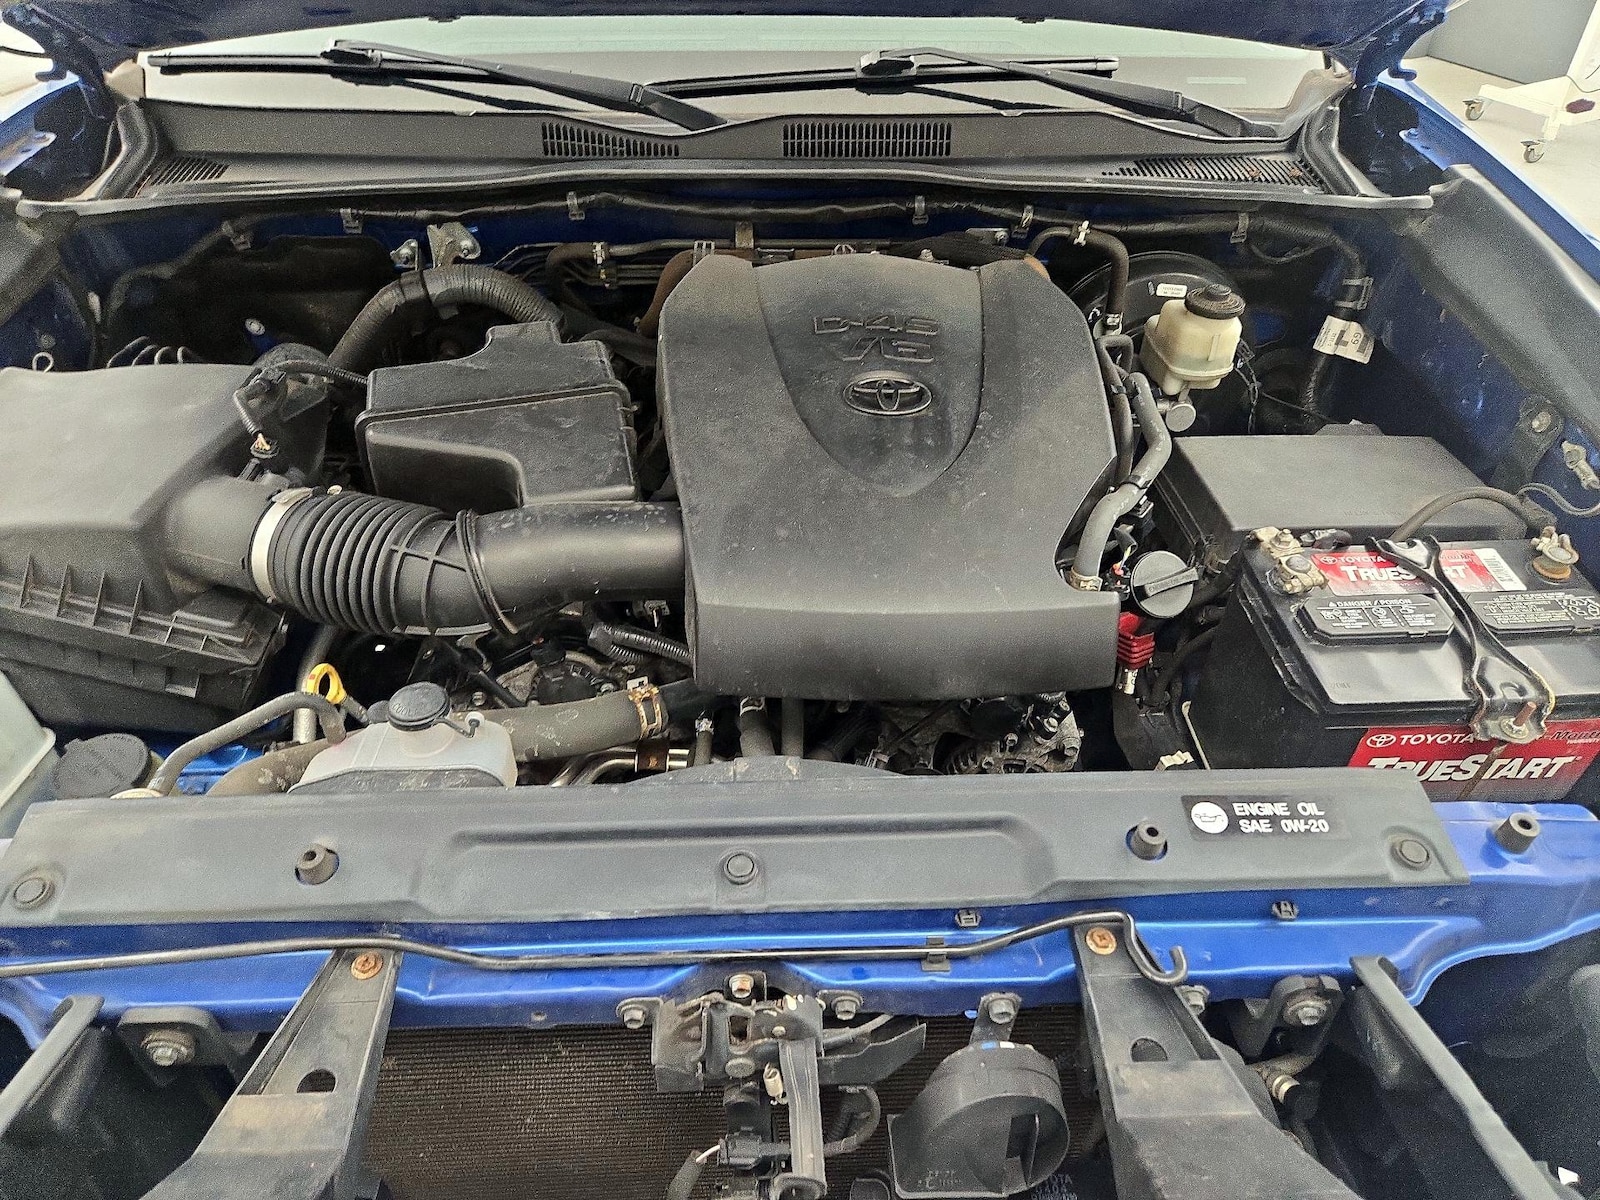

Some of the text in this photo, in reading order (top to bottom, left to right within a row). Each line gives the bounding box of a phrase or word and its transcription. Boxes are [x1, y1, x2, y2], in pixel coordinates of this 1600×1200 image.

[1339, 555, 1387, 563] TOYOTA
[1400, 733, 1475, 746] TOYOTA
[1231, 802, 1326, 816] ENGINE OIL
[1238, 819, 1330, 833] SAE 0W-20
